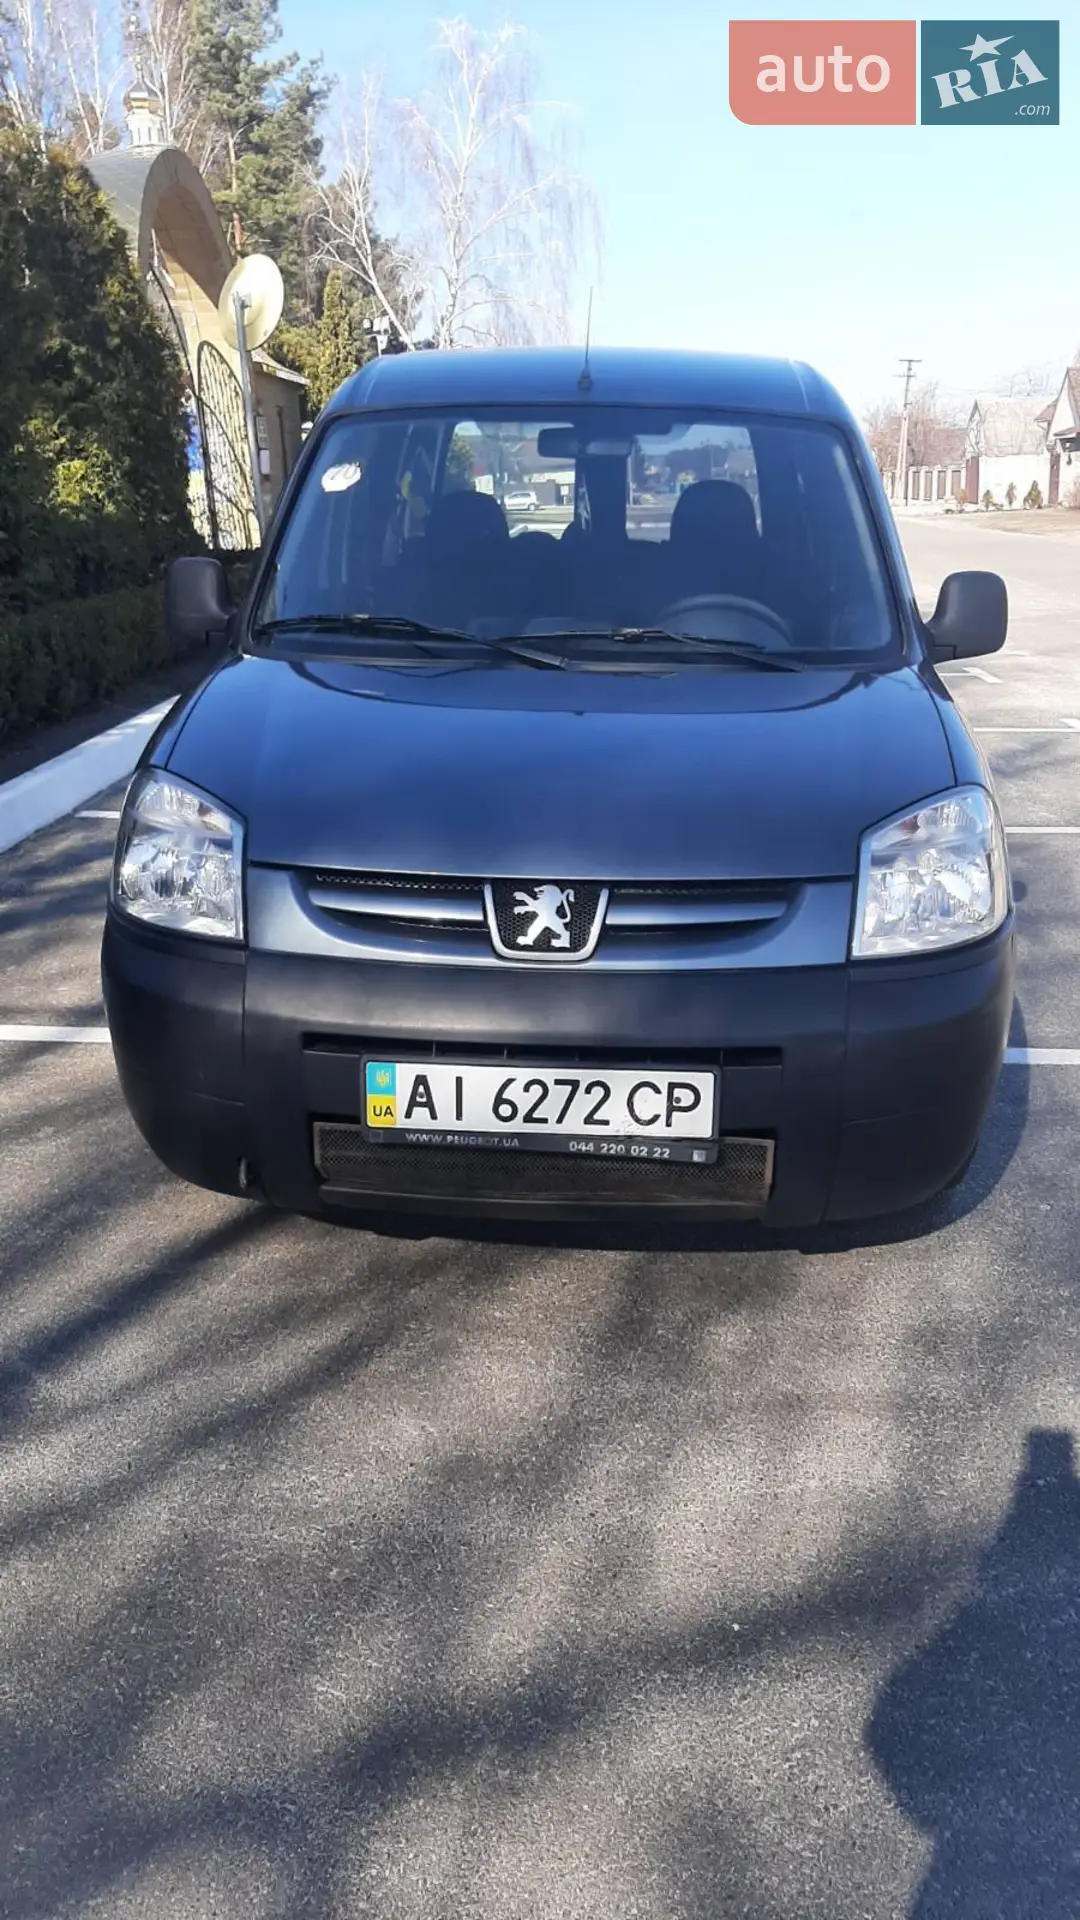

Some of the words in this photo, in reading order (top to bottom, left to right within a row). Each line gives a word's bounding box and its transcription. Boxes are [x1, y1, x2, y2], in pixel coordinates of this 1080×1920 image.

[404, 1074, 463, 1122] AI
[492, 1077, 611, 1126] 6272
[626, 1081, 702, 1128] CP
[372, 1105, 395, 1118] UA
[569, 1141, 594, 1153] 044
[600, 1143, 625, 1154] 220
[630, 1145, 648, 1157] 02
[653, 1147, 670, 1159] 22
